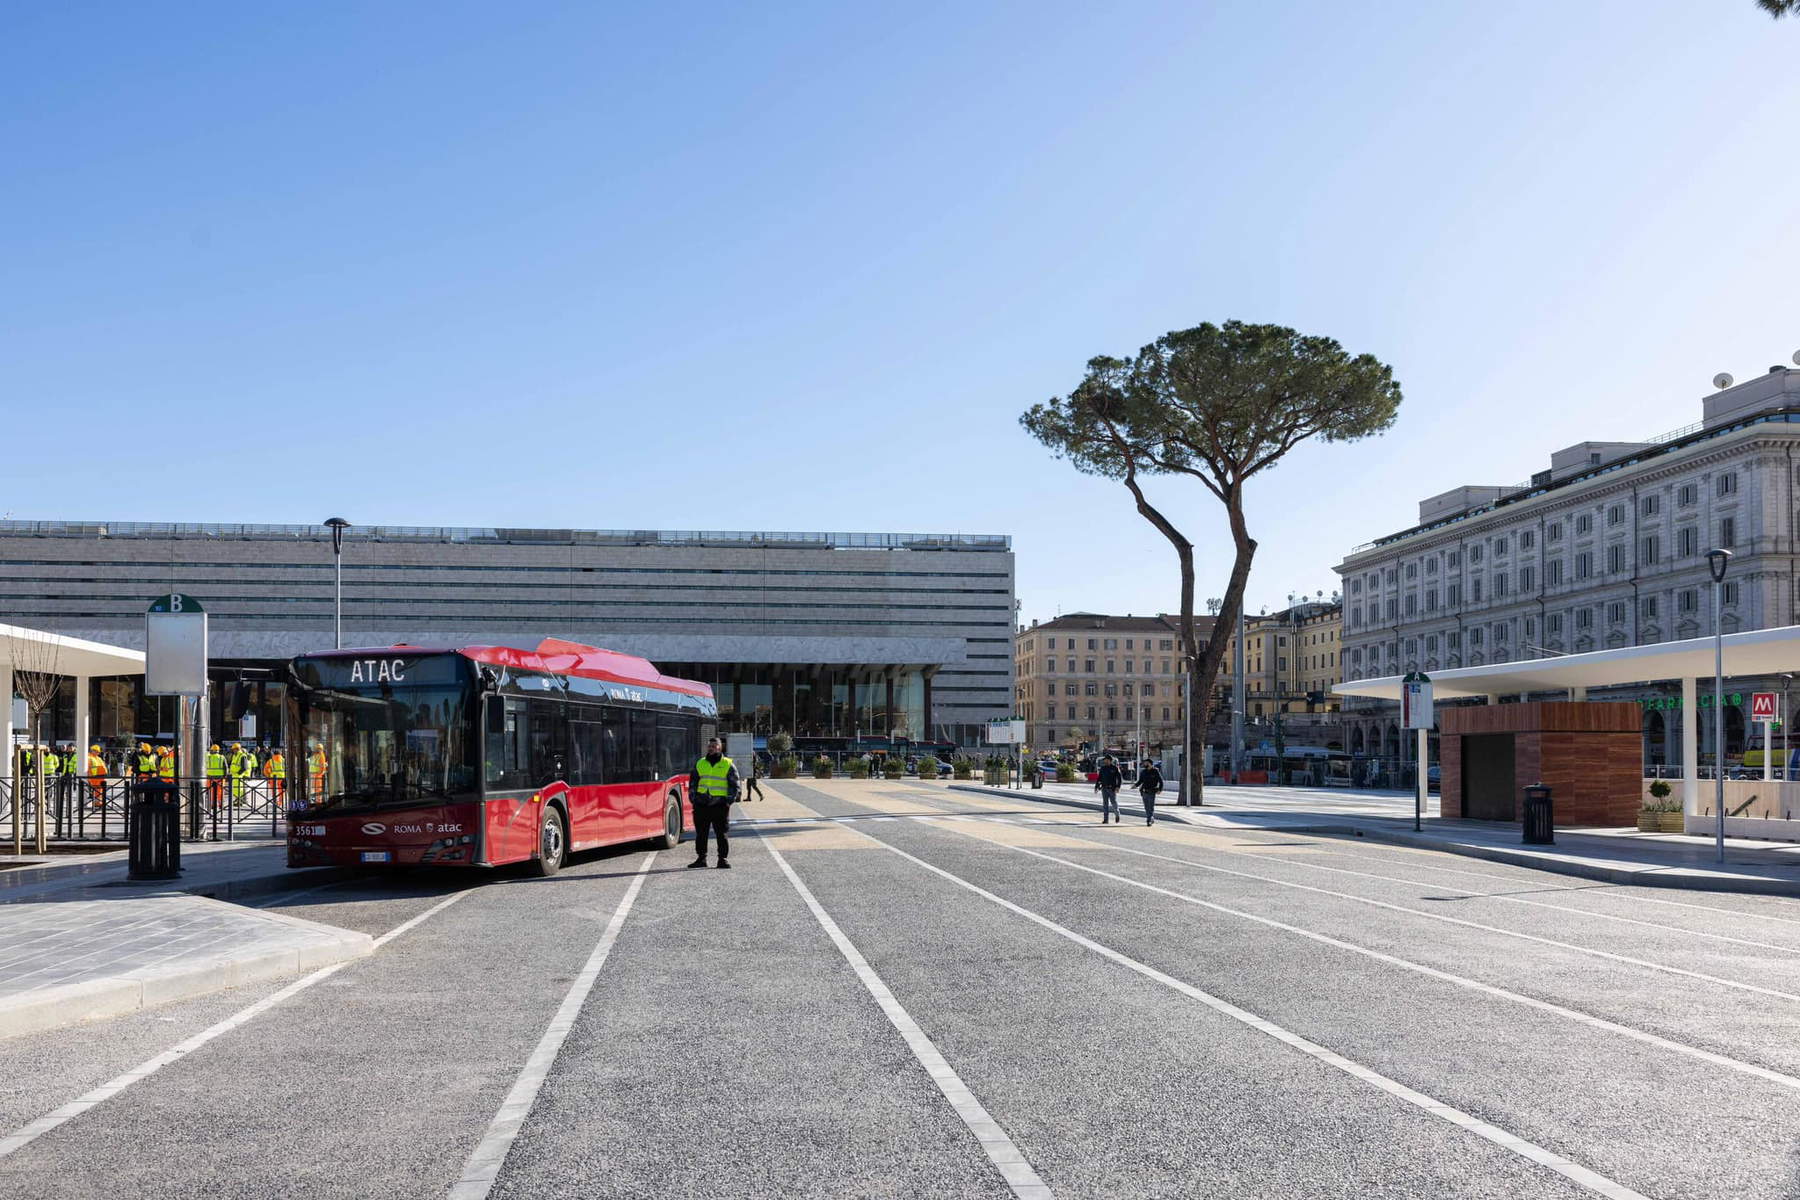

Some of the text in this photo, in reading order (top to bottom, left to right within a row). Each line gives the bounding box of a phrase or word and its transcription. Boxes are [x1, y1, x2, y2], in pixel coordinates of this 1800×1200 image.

[171, 594, 183, 612] B
[351, 659, 405, 682] ATAC
[1755, 697, 1772, 711] M
[296, 825, 315, 836] 3561
[394, 822, 462, 834] ROMA atac
